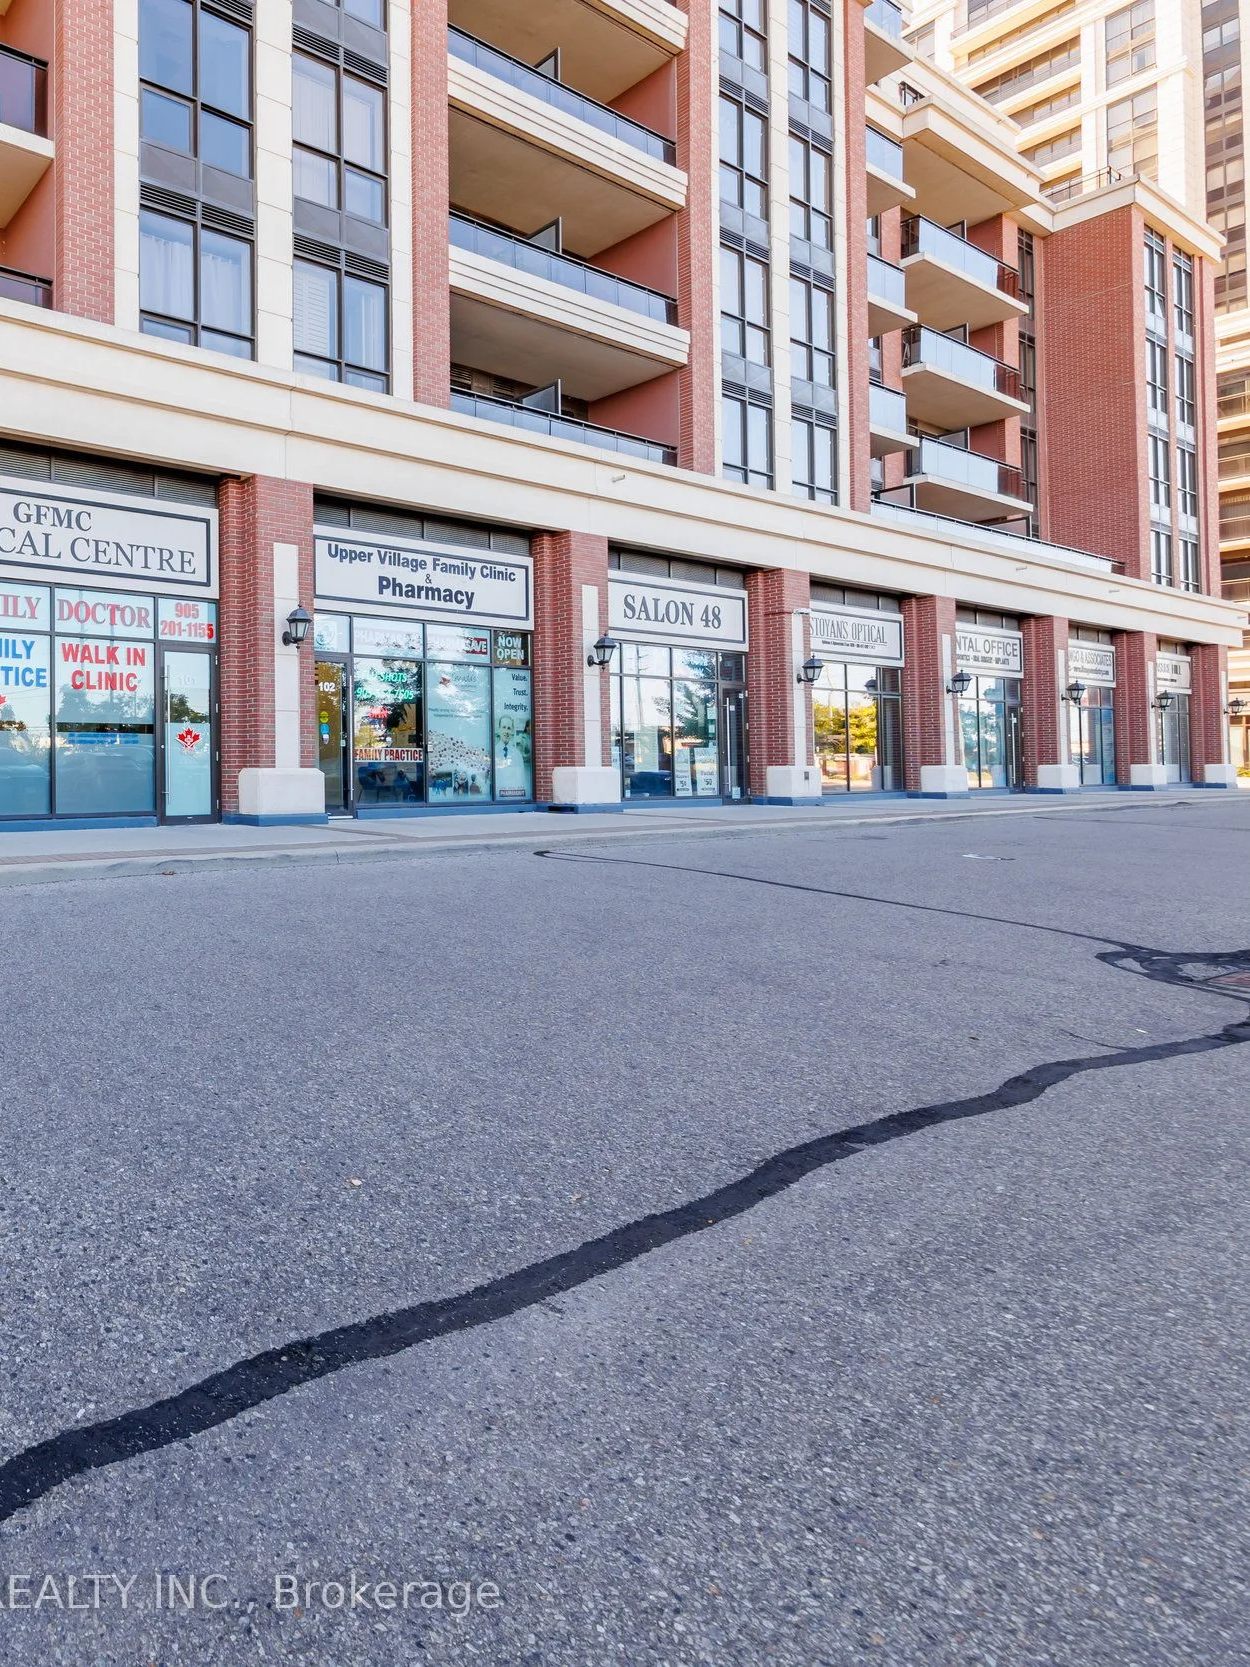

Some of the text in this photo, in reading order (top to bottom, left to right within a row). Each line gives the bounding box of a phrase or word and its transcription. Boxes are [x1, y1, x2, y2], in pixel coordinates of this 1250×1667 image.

[12, 501, 92, 532] GFMC
[70, 537, 196, 575] CENTRE
[327, 543, 516, 582] Upper Village Family Clinic
[425, 573, 432, 584] &
[378, 575, 475, 610] Pharmacy
[57, 598, 151, 628] DOCTOR
[175, 602, 199, 619] 905
[623, 594, 721, 629] SALON 48
[160, 620, 214, 639] 201-1155
[852, 623, 887, 644] OPTICAL
[497, 635, 522, 648] NOW
[983, 639, 1018, 657] OFFICE
[61, 642, 146, 667] WALK IN
[496, 648, 524, 660] OPEN
[71, 670, 138, 692] CLINIC
[318, 681, 336, 692] 102
[511, 673, 528, 682] Value.
[513, 688, 529, 696] Trust.
[504, 702, 529, 712] Integrity.
[354, 748, 423, 761] FAMILY PRACTICE
